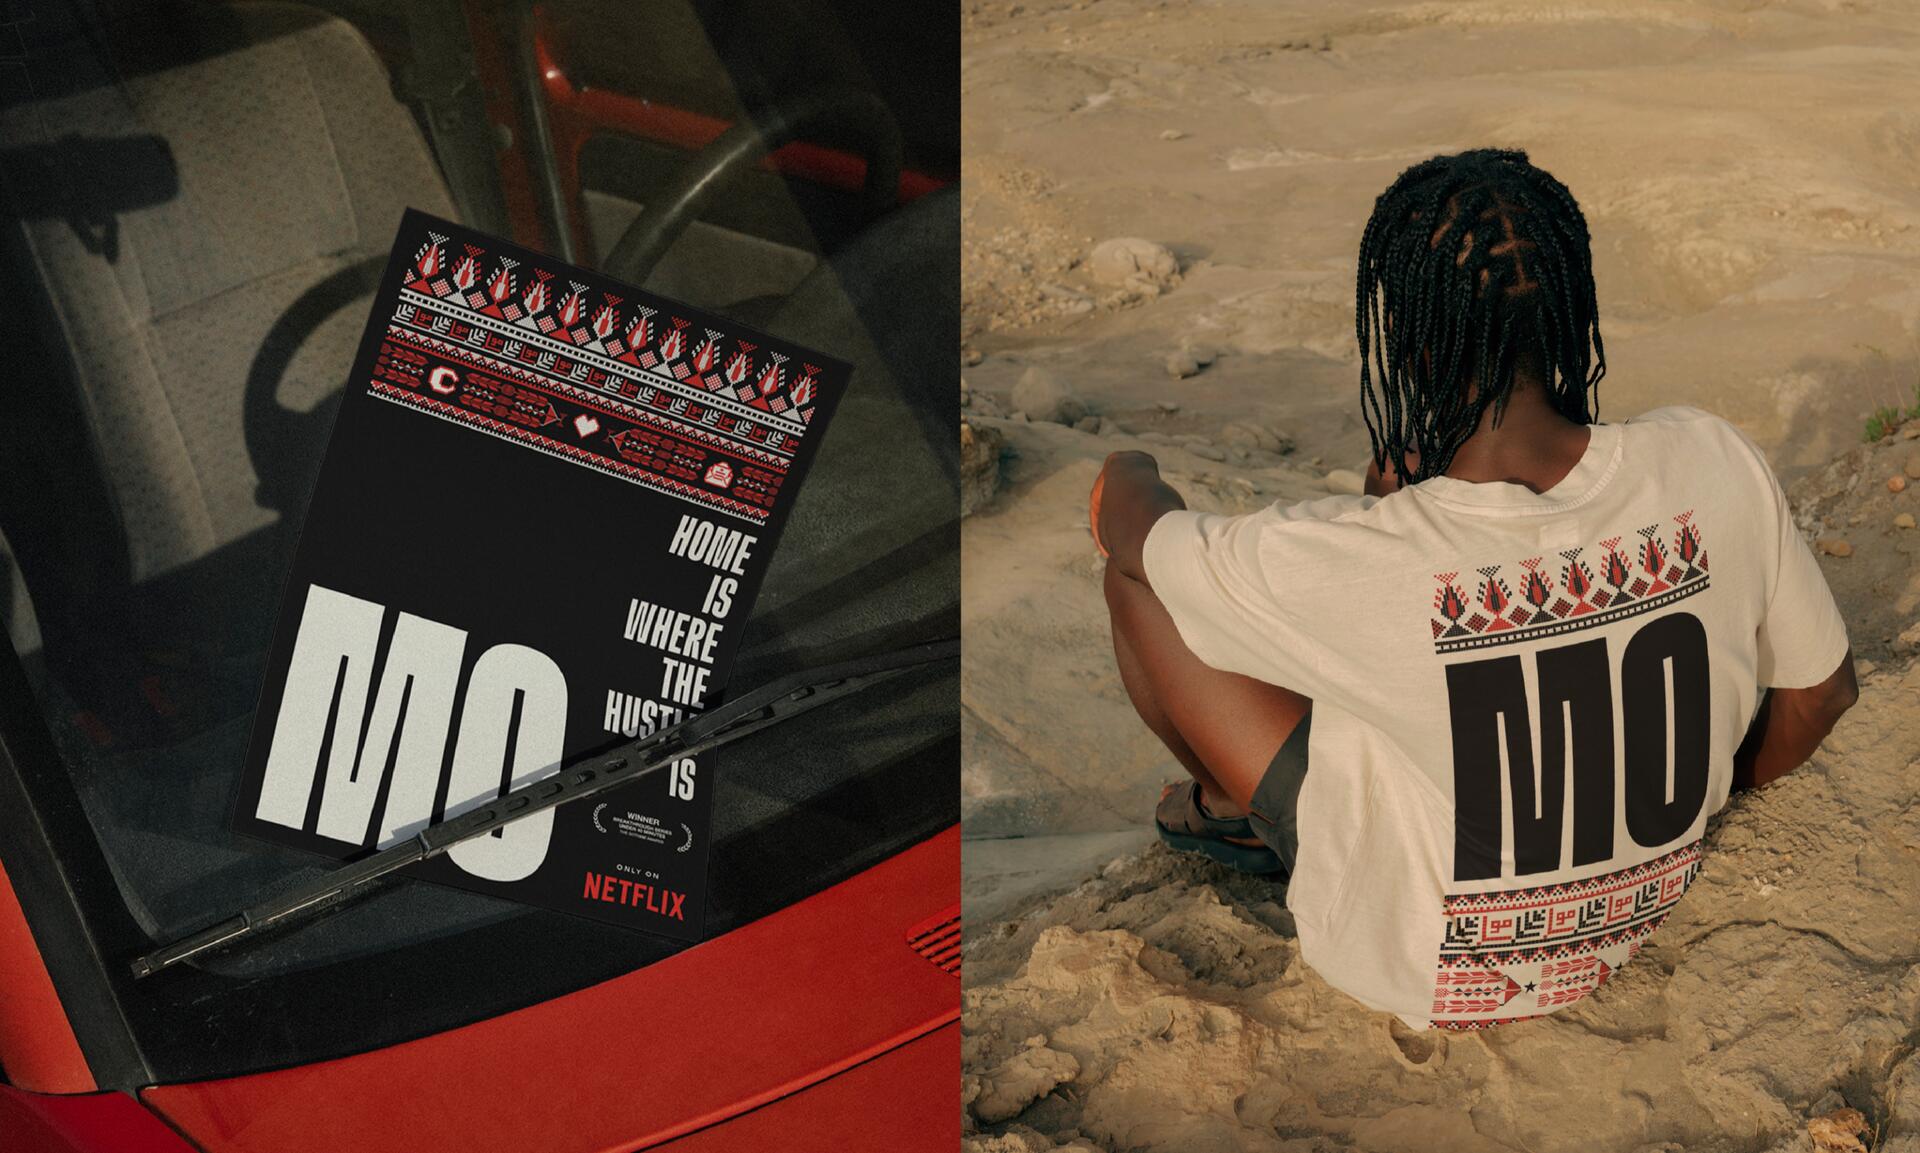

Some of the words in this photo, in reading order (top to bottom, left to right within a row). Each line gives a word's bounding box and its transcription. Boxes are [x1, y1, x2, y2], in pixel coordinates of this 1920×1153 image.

[669, 515, 757, 575] HOME
[702, 575, 738, 618] IS
[624, 598, 723, 664] WHERE
[661, 657, 711, 708] THE
[256, 584, 568, 881] MO
[603, 689, 698, 740] HUST
[1445, 612, 1711, 882] MO
[669, 758, 696, 801] IS
[627, 811, 660, 826] WINNER
[583, 871, 686, 921] NETFLIX
[616, 863, 642, 875] ONLY
[645, 871, 660, 880] ON
